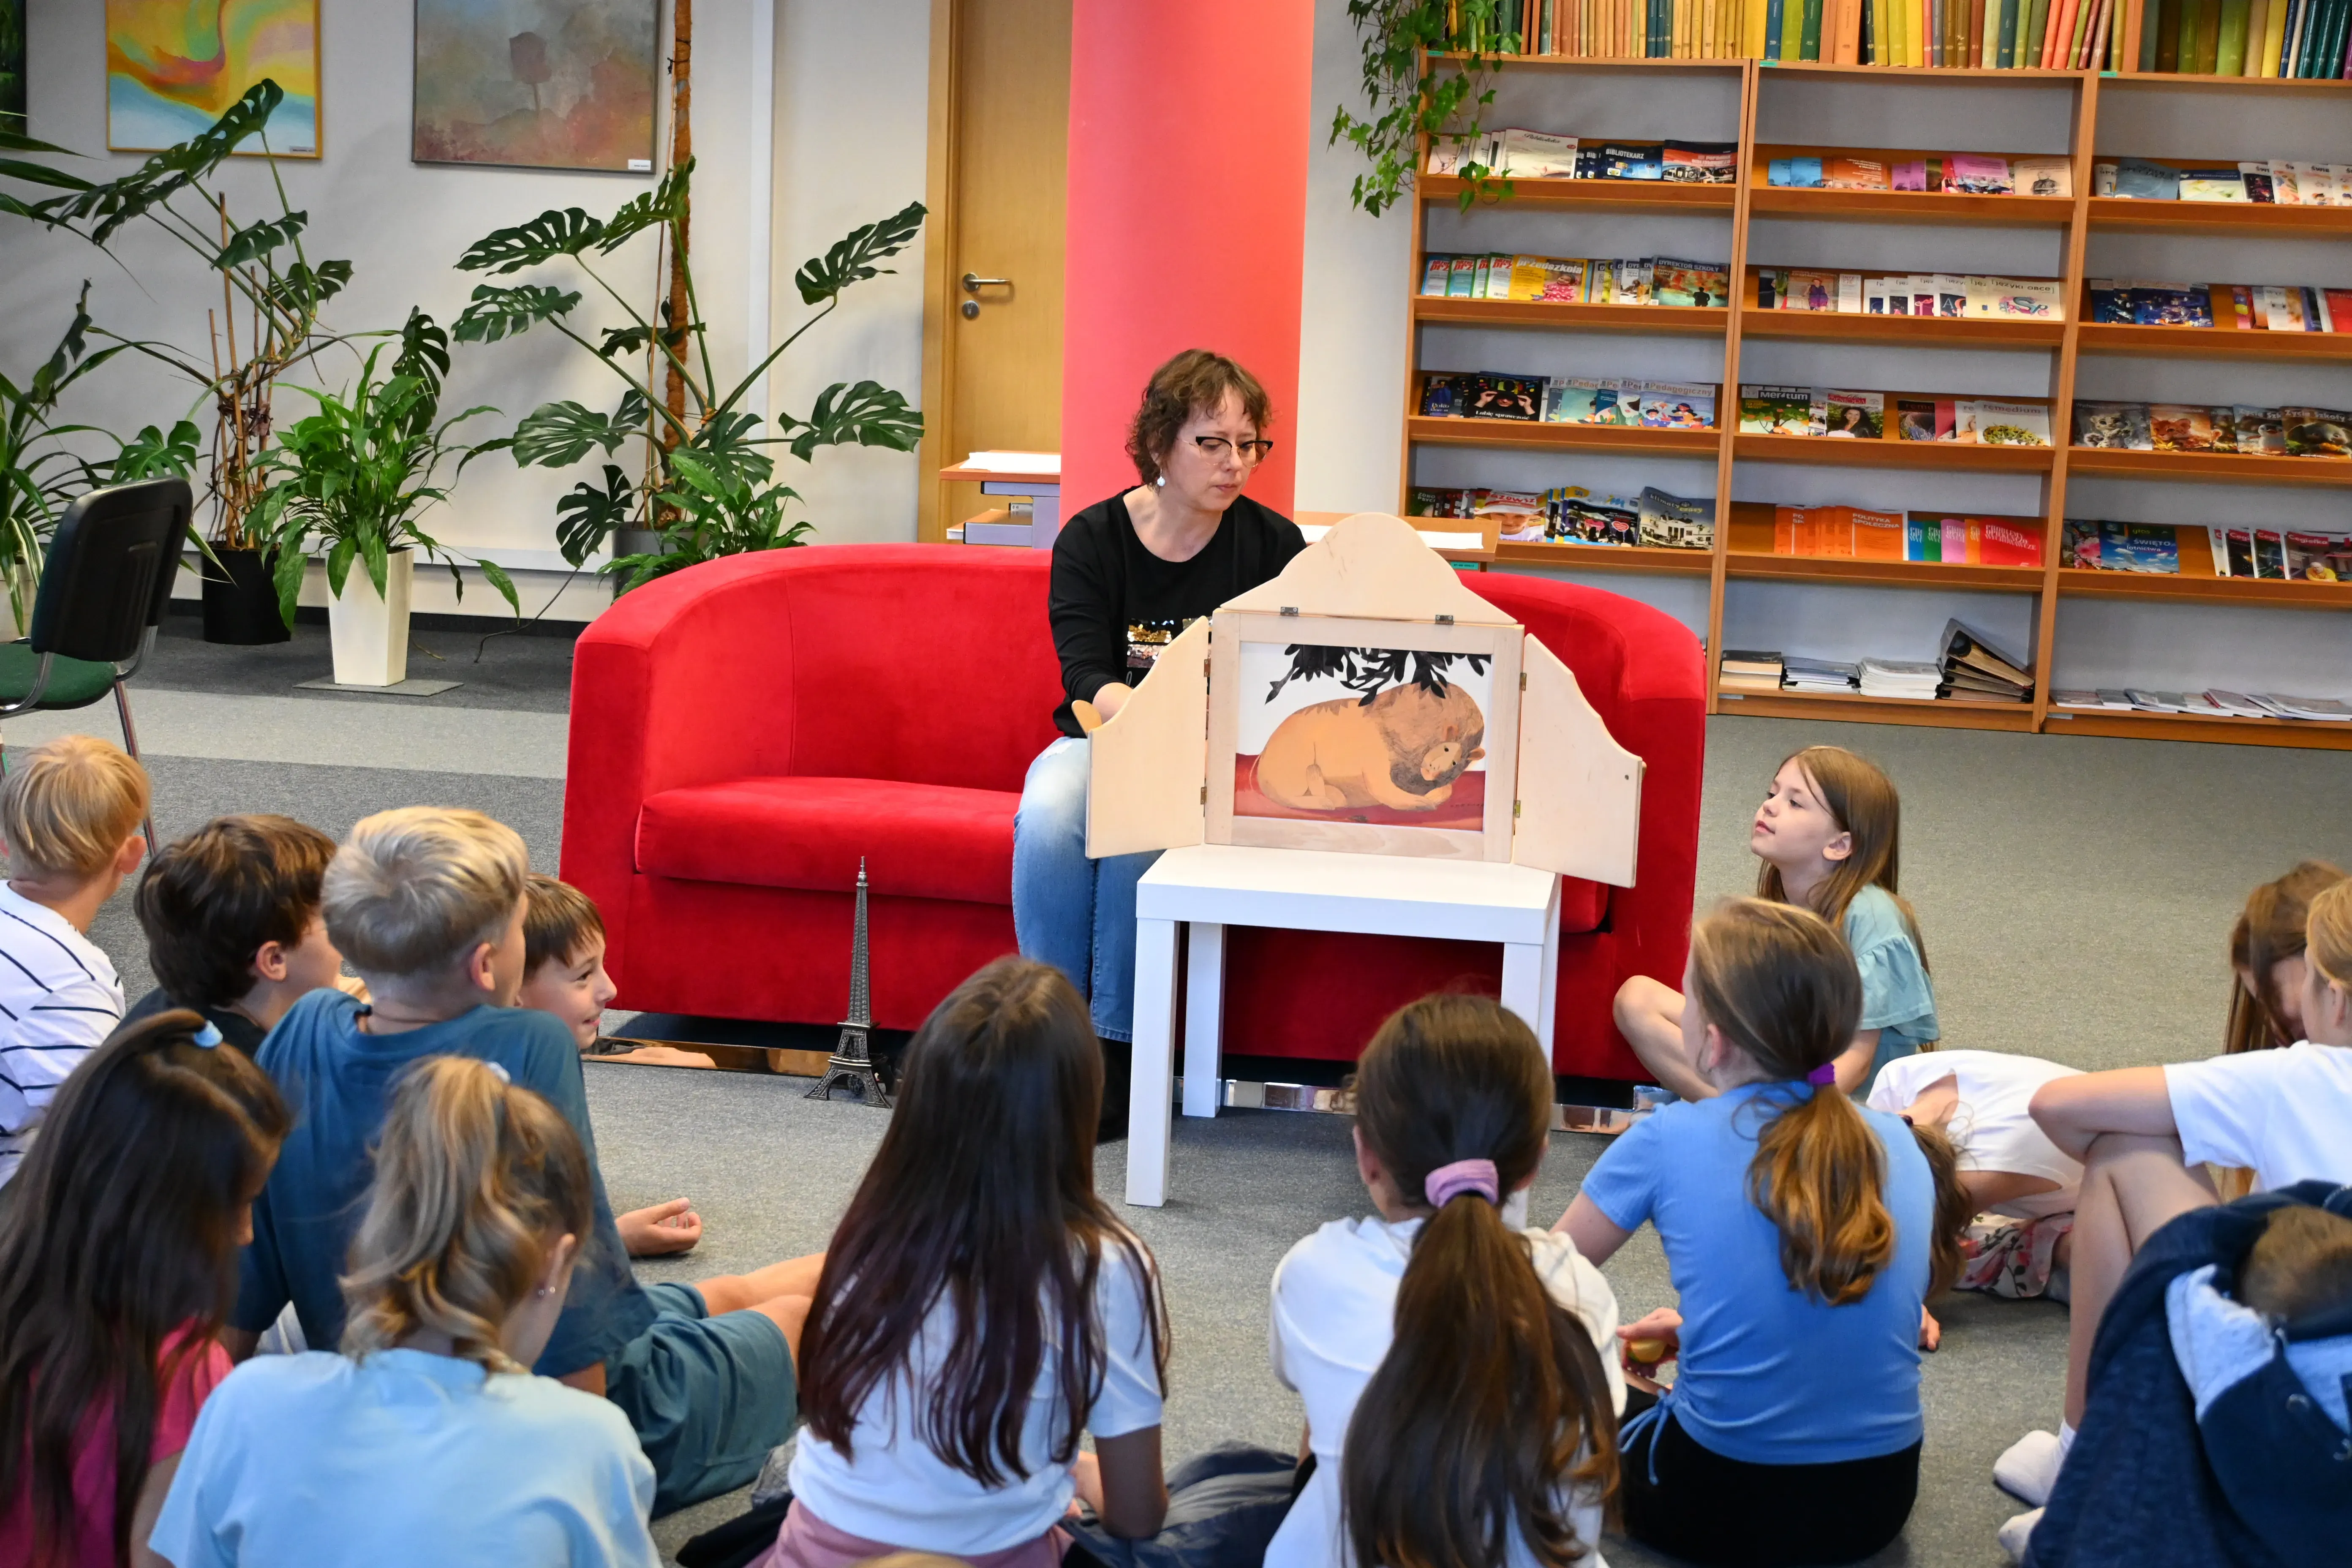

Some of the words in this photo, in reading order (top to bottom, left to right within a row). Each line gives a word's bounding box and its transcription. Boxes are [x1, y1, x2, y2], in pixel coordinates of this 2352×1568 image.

[1606, 148, 1644, 159] BIBLIOTEKARZ
[1658, 260, 1693, 270] DYREKTOR
[1693, 265, 1719, 273] SZKOŁY
[1649, 383, 1712, 396] Pedagogiczny
[1984, 404, 2040, 414] remedium
[1852, 513, 1891, 523] POLITYKA
[1852, 518, 1900, 528] SPOŁECZNA
[2134, 538, 2171, 547] ŚWIĘTO
